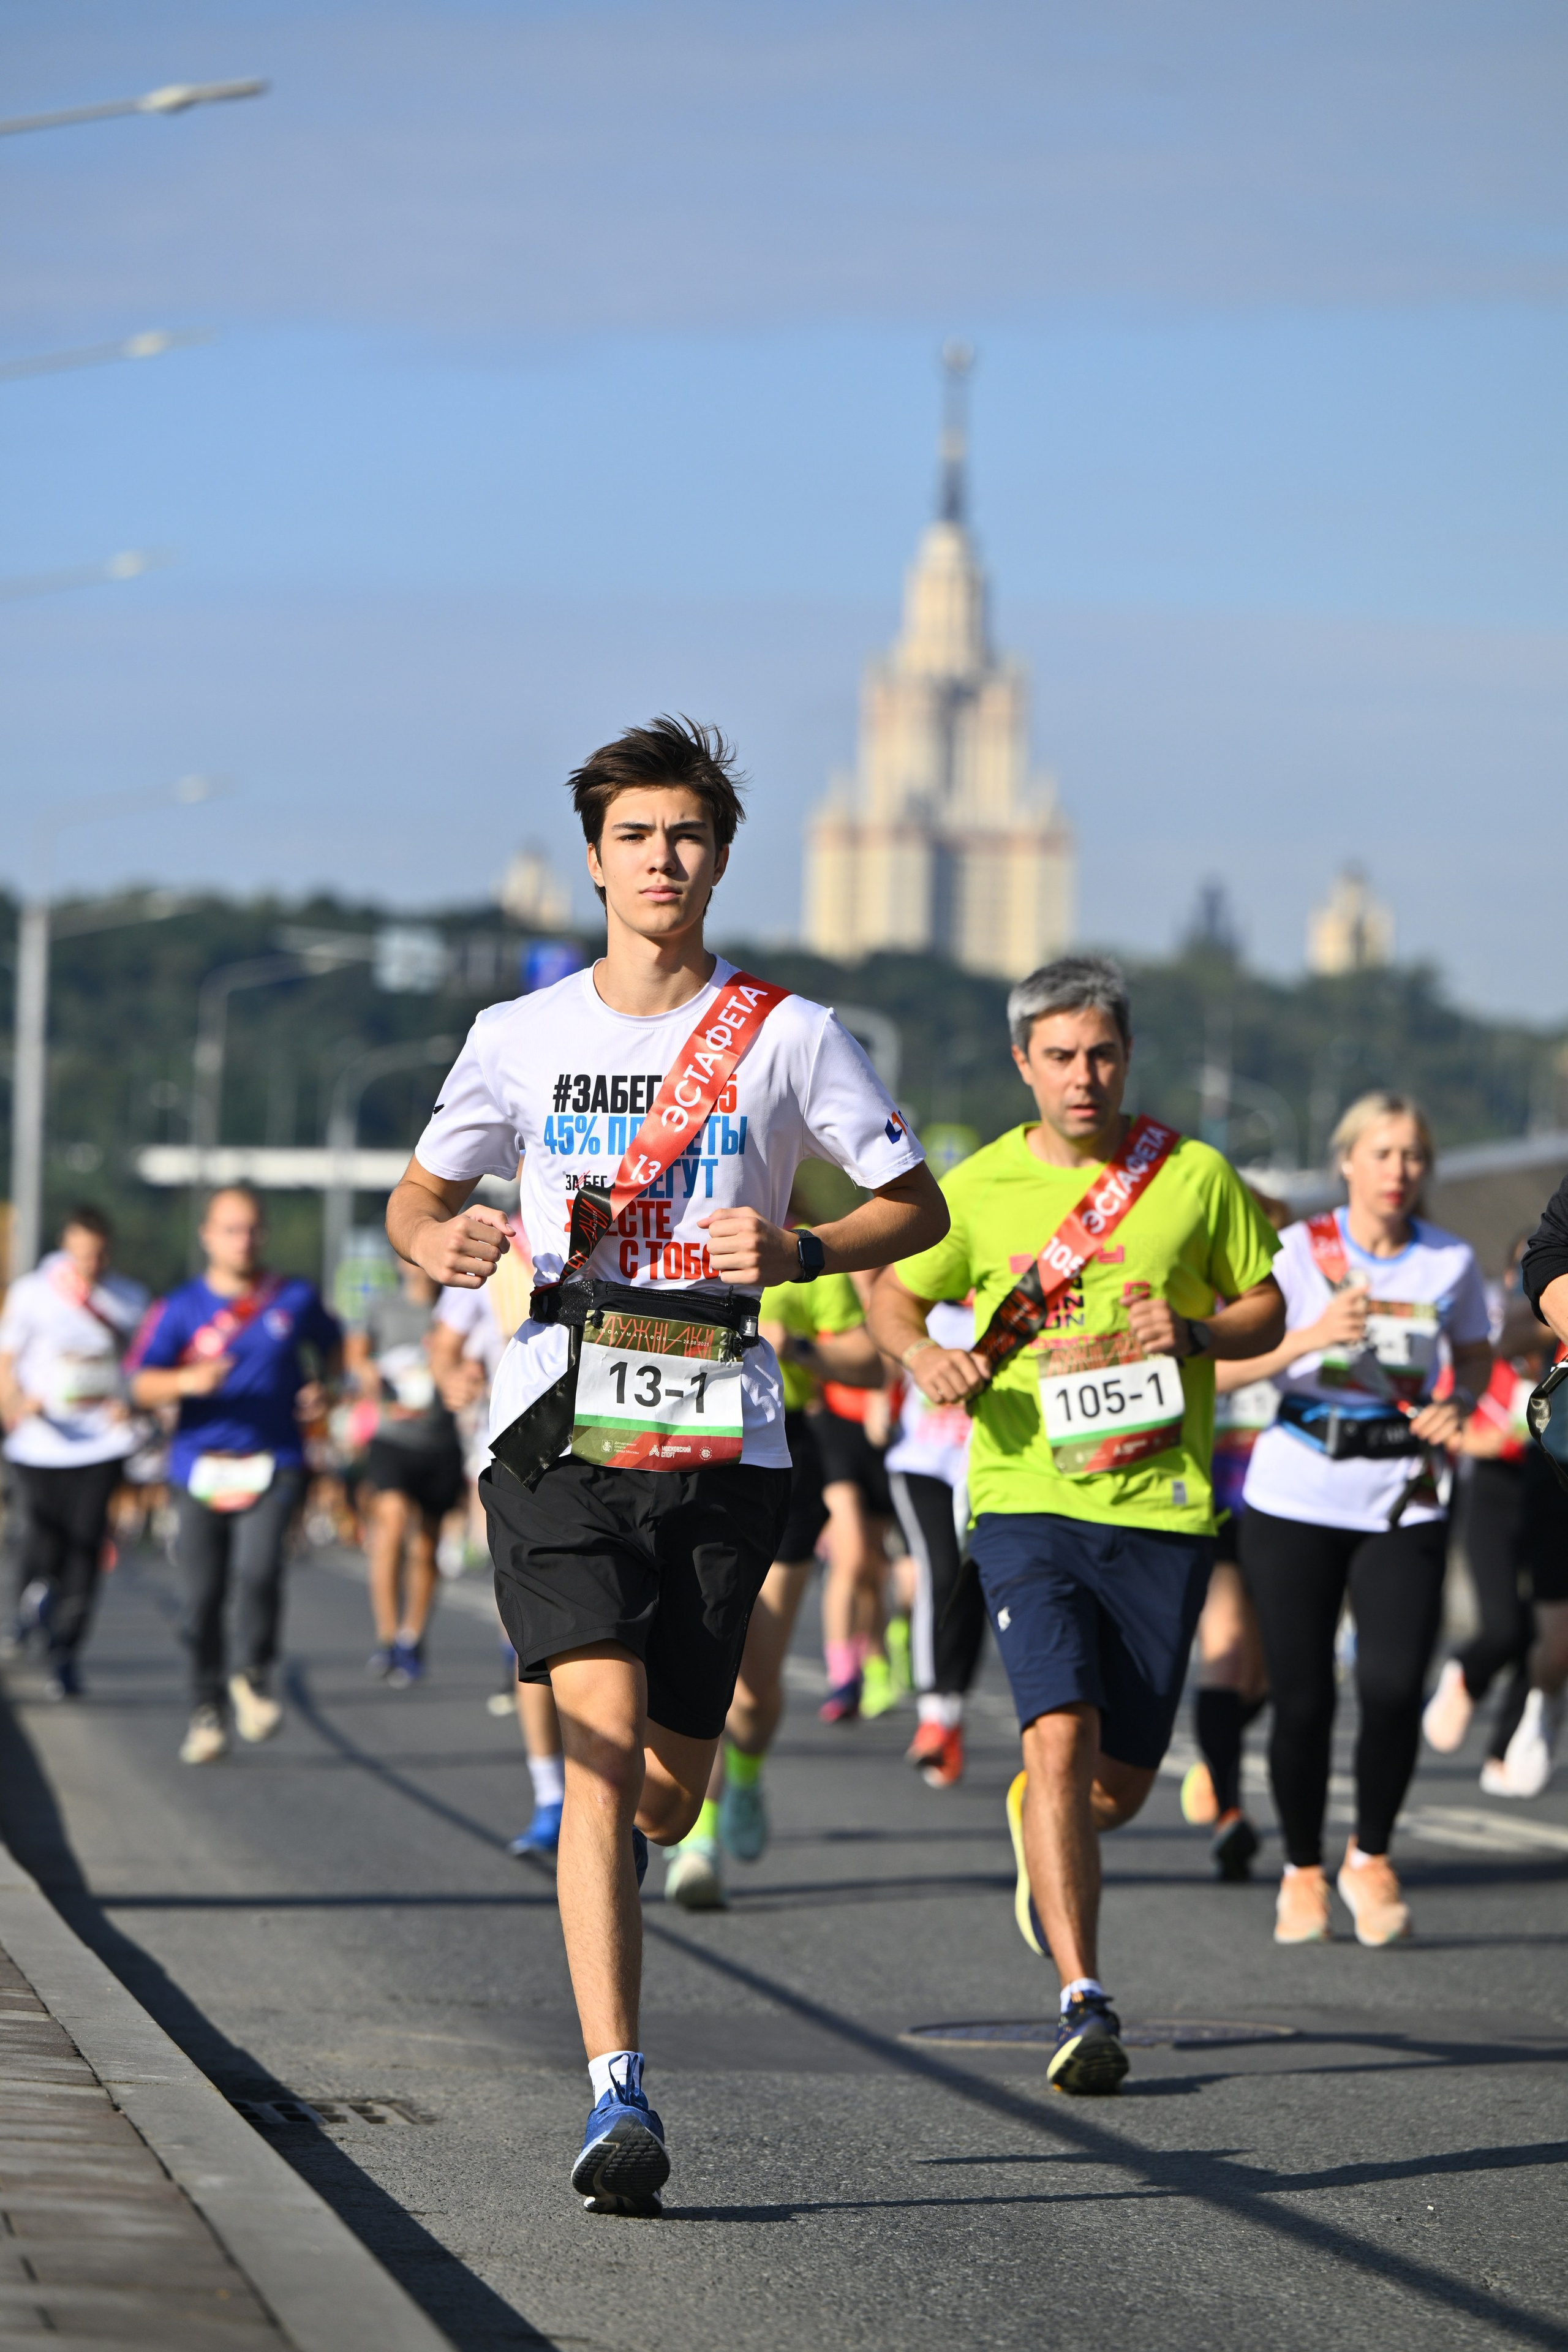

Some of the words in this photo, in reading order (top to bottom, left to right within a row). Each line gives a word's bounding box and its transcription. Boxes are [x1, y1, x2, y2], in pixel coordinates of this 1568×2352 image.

[661, 985, 768, 1133] ЭСТАФЕТА
[543, 1115, 601, 1155] 45%
[630, 1154, 662, 1185] 13
[1081, 1126, 1170, 1234] ЭСТАФЕТА
[619, 1239, 639, 1280] С
[1042, 1235, 1086, 1279] 105
[601, 1328, 666, 1341] ПОЛУМАРАФОН
[683, 1339, 710, 1348] 24.08.2025
[609, 1361, 707, 1414] 13-1
[1057, 1373, 1164, 1421] 105-1
[662, 1445, 691, 1453] МОСКОВСКИЙ
